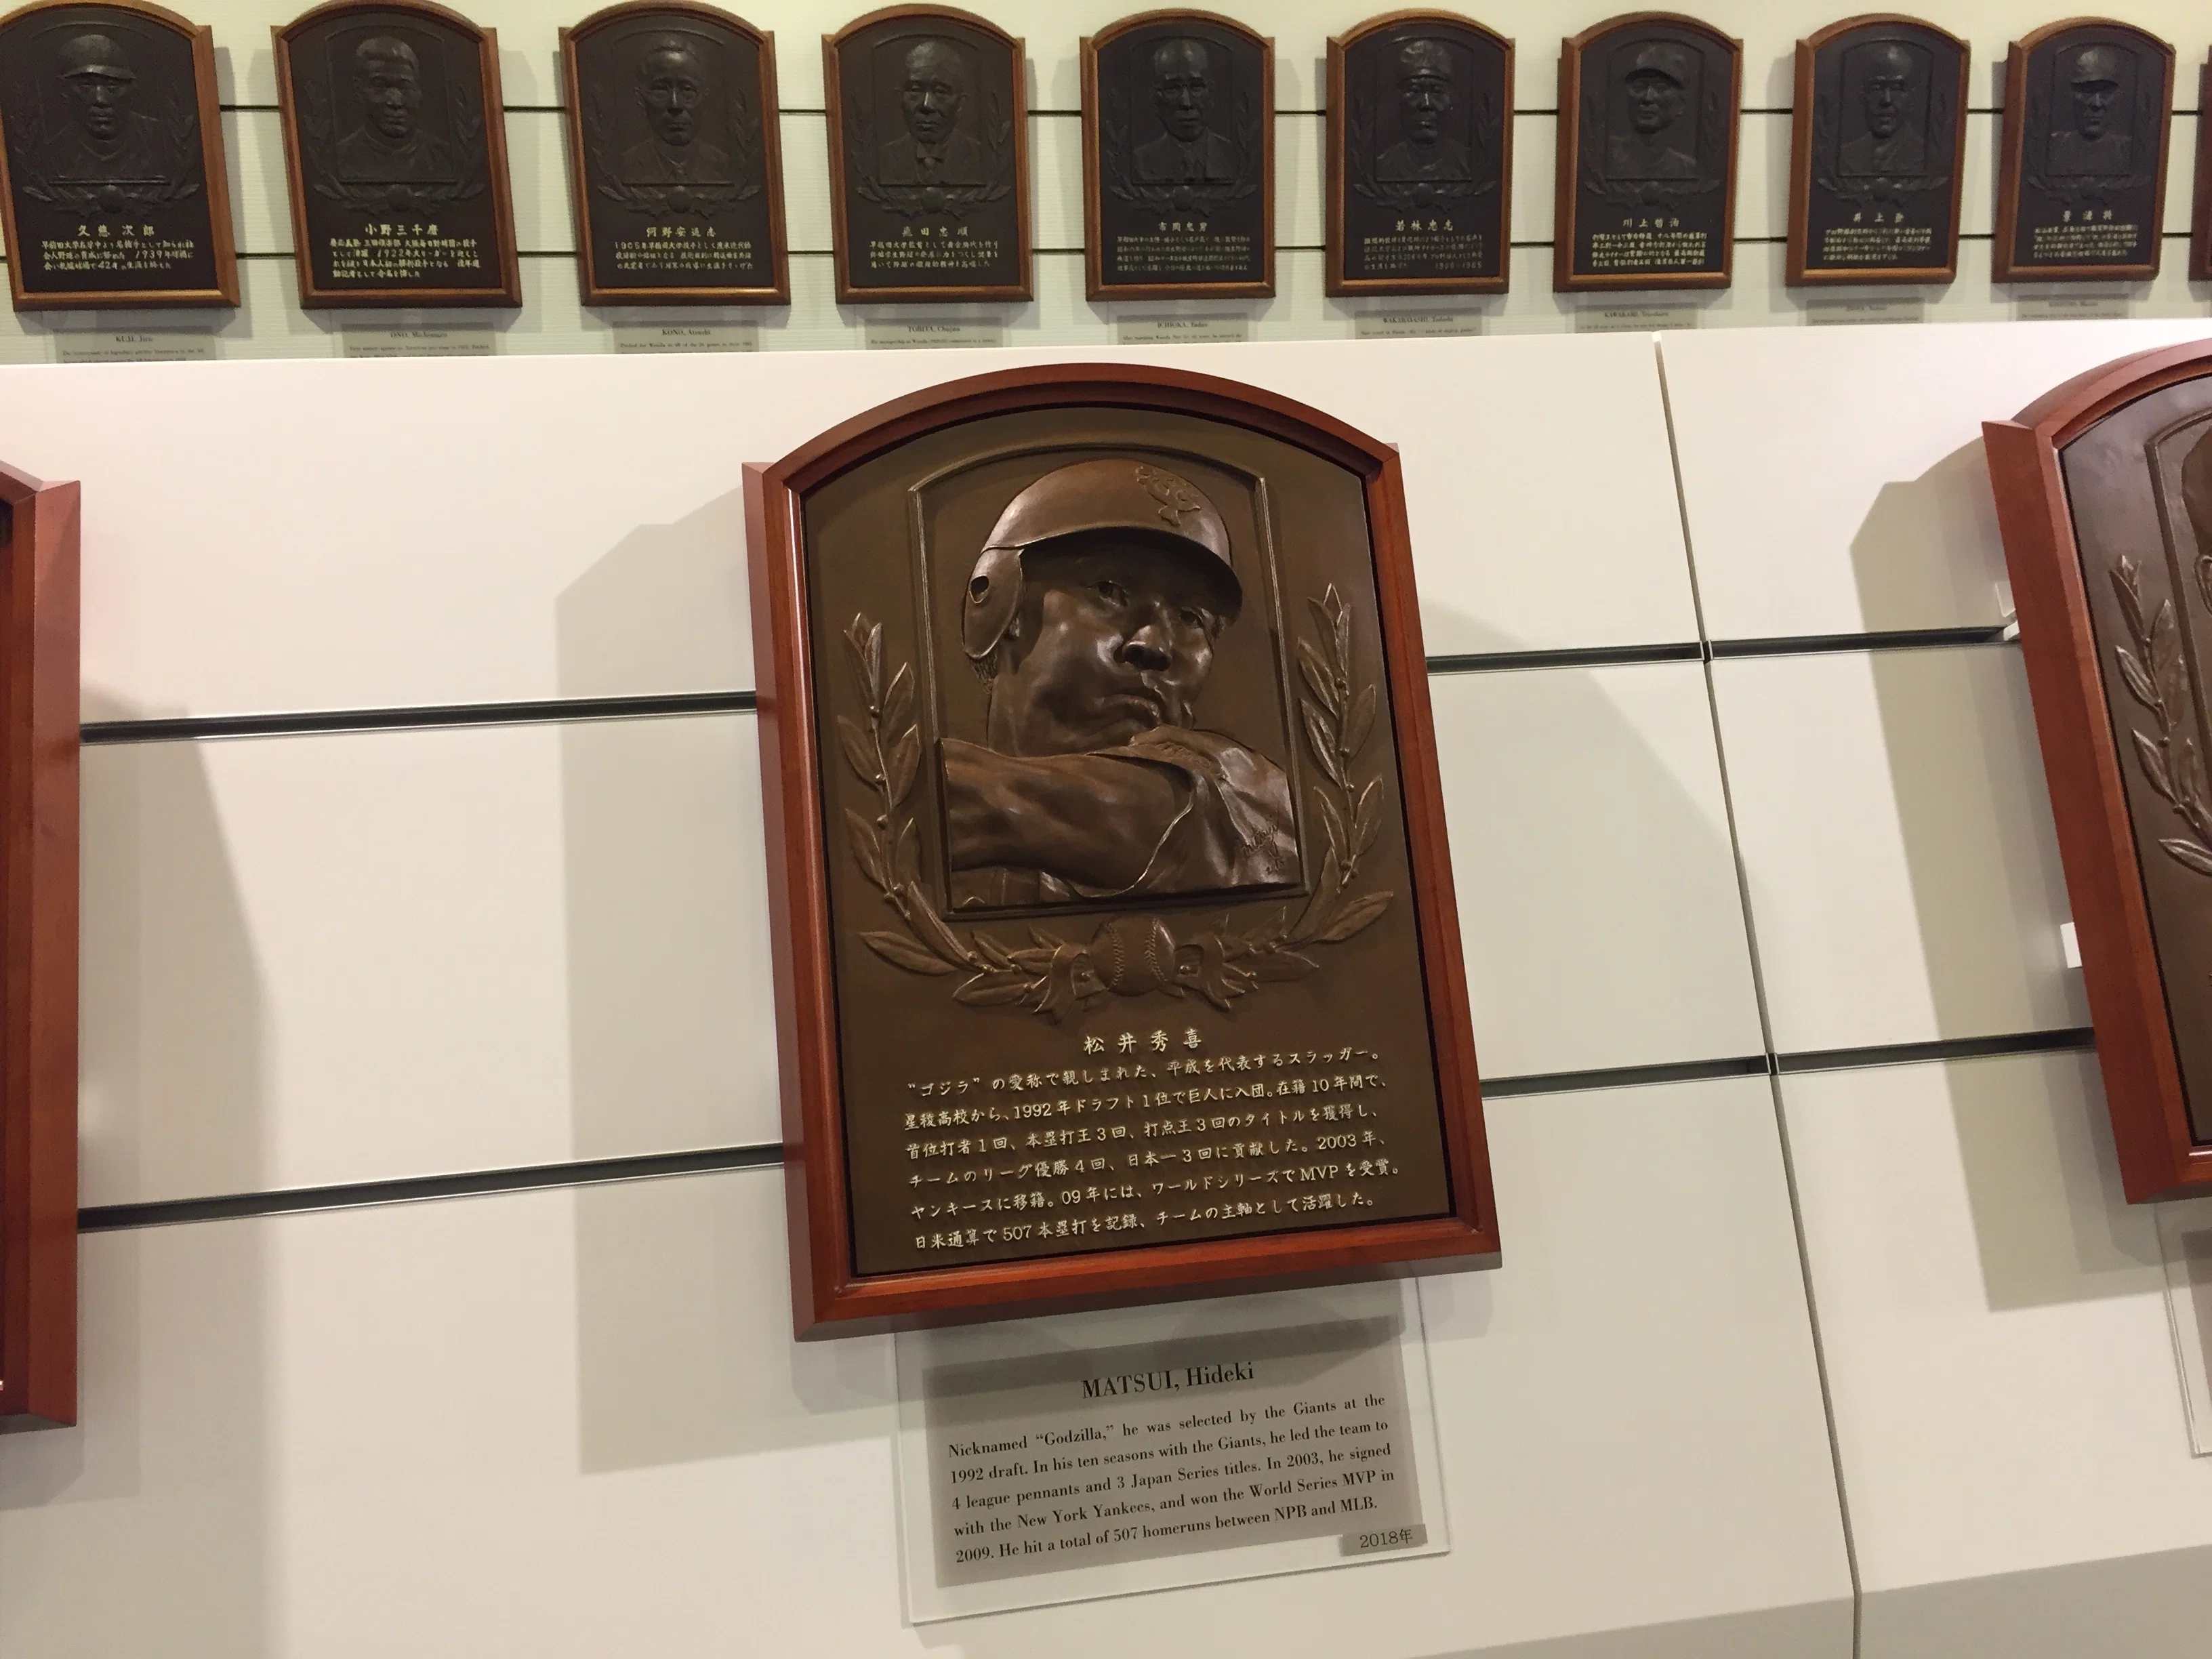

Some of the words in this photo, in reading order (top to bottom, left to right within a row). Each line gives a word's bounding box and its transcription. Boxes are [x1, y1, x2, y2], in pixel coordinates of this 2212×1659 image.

[1084, 1027, 1202, 1054] 松井秀喜
[1082, 1370, 1180, 1399] MATSUI,
[1186, 1361, 1254, 1387] Hideki
[948, 1435, 1027, 1458] Nicknamed
[1035, 1424, 1114, 1446] “Godzilla,”
[1122, 1422, 1139, 1437] he
[1146, 1422, 1171, 1433] was
[1179, 1410, 1233, 1429] selected
[1239, 1408, 1256, 1425] by
[1264, 1404, 1286, 1419] the
[1292, 1401, 1337, 1416] Giants
[1343, 1398, 1357, 1410] at
[1364, 1393, 1385, 1408] the
[951, 1467, 984, 1484] 1992
[988, 1461, 1029, 1479] draft.
[1033, 1459, 1048, 1474] In
[1052, 1456, 1073, 1471] his
[1077, 1456, 1099, 1469] ten
[1103, 1450, 1155, 1465] seasons
[1158, 1441, 1188, 1458] with
[1192, 1439, 1214, 1454] the
[1217, 1435, 1266, 1450] Giants,
[1269, 1430, 1286, 1444] he
[1289, 1426, 1310, 1442] led
[1313, 1424, 1336, 1439] the
[1339, 1423, 1372, 1436] team
[1375, 1420, 1389, 1431] to
[951, 1496, 961, 1510] 4
[966, 1494, 1010, 1511] league
[1016, 1484, 1080, 1507] pennants
[1085, 1476, 1111, 1494] and
[1116, 1475, 1125, 1489] 3
[1130, 1473, 1172, 1490] Japan
[1176, 1465, 1219, 1482] Series
[1224, 1460, 1261, 1475] titles.
[1266, 1456, 1282, 1470] In
[1286, 1451, 1324, 1468] 2003,
[1328, 1448, 1345, 1462] he
[1349, 1441, 1391, 1462] signed
[953, 1519, 985, 1537] with
[990, 1517, 1012, 1532] the
[1017, 1513, 1047, 1528] New
[1051, 1506, 1088, 1524] York
[1092, 1500, 1155, 1518] Yankees,
[1160, 1493, 1186, 1510] and
[1190, 1494, 1218, 1506] won
[1223, 1487, 1245, 1502] the
[1248, 1479, 1292, 1498] World
[1296, 1476, 1338, 1492] Series
[1342, 1469, 1376, 1486] MVP
[1380, 1469, 1395, 1482] in
[956, 1546, 995, 1563] 2009.
[998, 1542, 1019, 1558] He
[1023, 1539, 1043, 1555] hit
[1047, 1541, 1056, 1551] a
[1059, 1532, 1092, 1550] total
[1094, 1529, 1110, 1544] of
[1113, 1526, 1138, 1542] 507
[1142, 1521, 1211, 1538] homeruns
[1214, 1513, 1271, 1529] between
[1274, 1504, 1307, 1521] NPB
[1311, 1500, 1336, 1517] and
[1339, 1496, 1378, 1513] MLB.
[1358, 1528, 1414, 1549] 2018年
